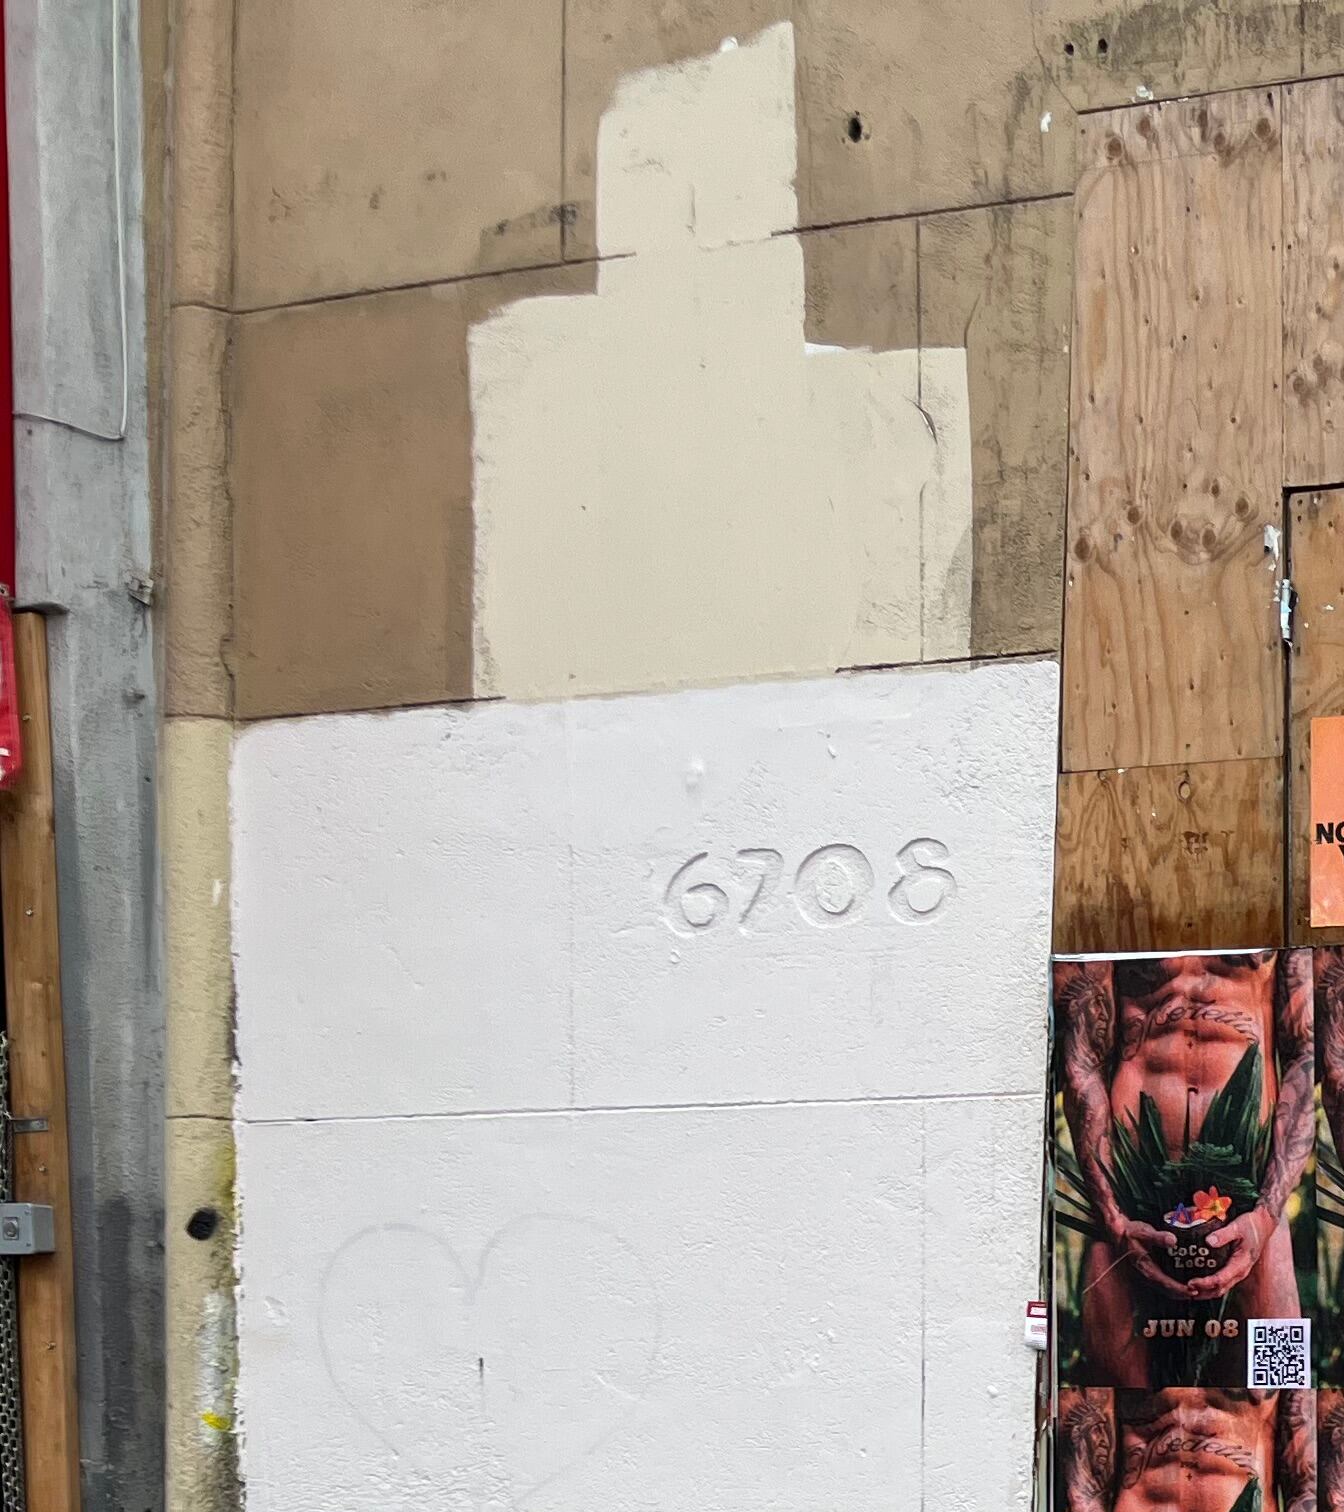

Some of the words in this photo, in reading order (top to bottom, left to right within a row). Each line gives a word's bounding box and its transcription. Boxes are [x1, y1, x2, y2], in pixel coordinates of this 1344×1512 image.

[663, 837, 957, 937] 6708
[1143, 1319, 1195, 1337] JUN
[1204, 1319, 1239, 1337] 08
